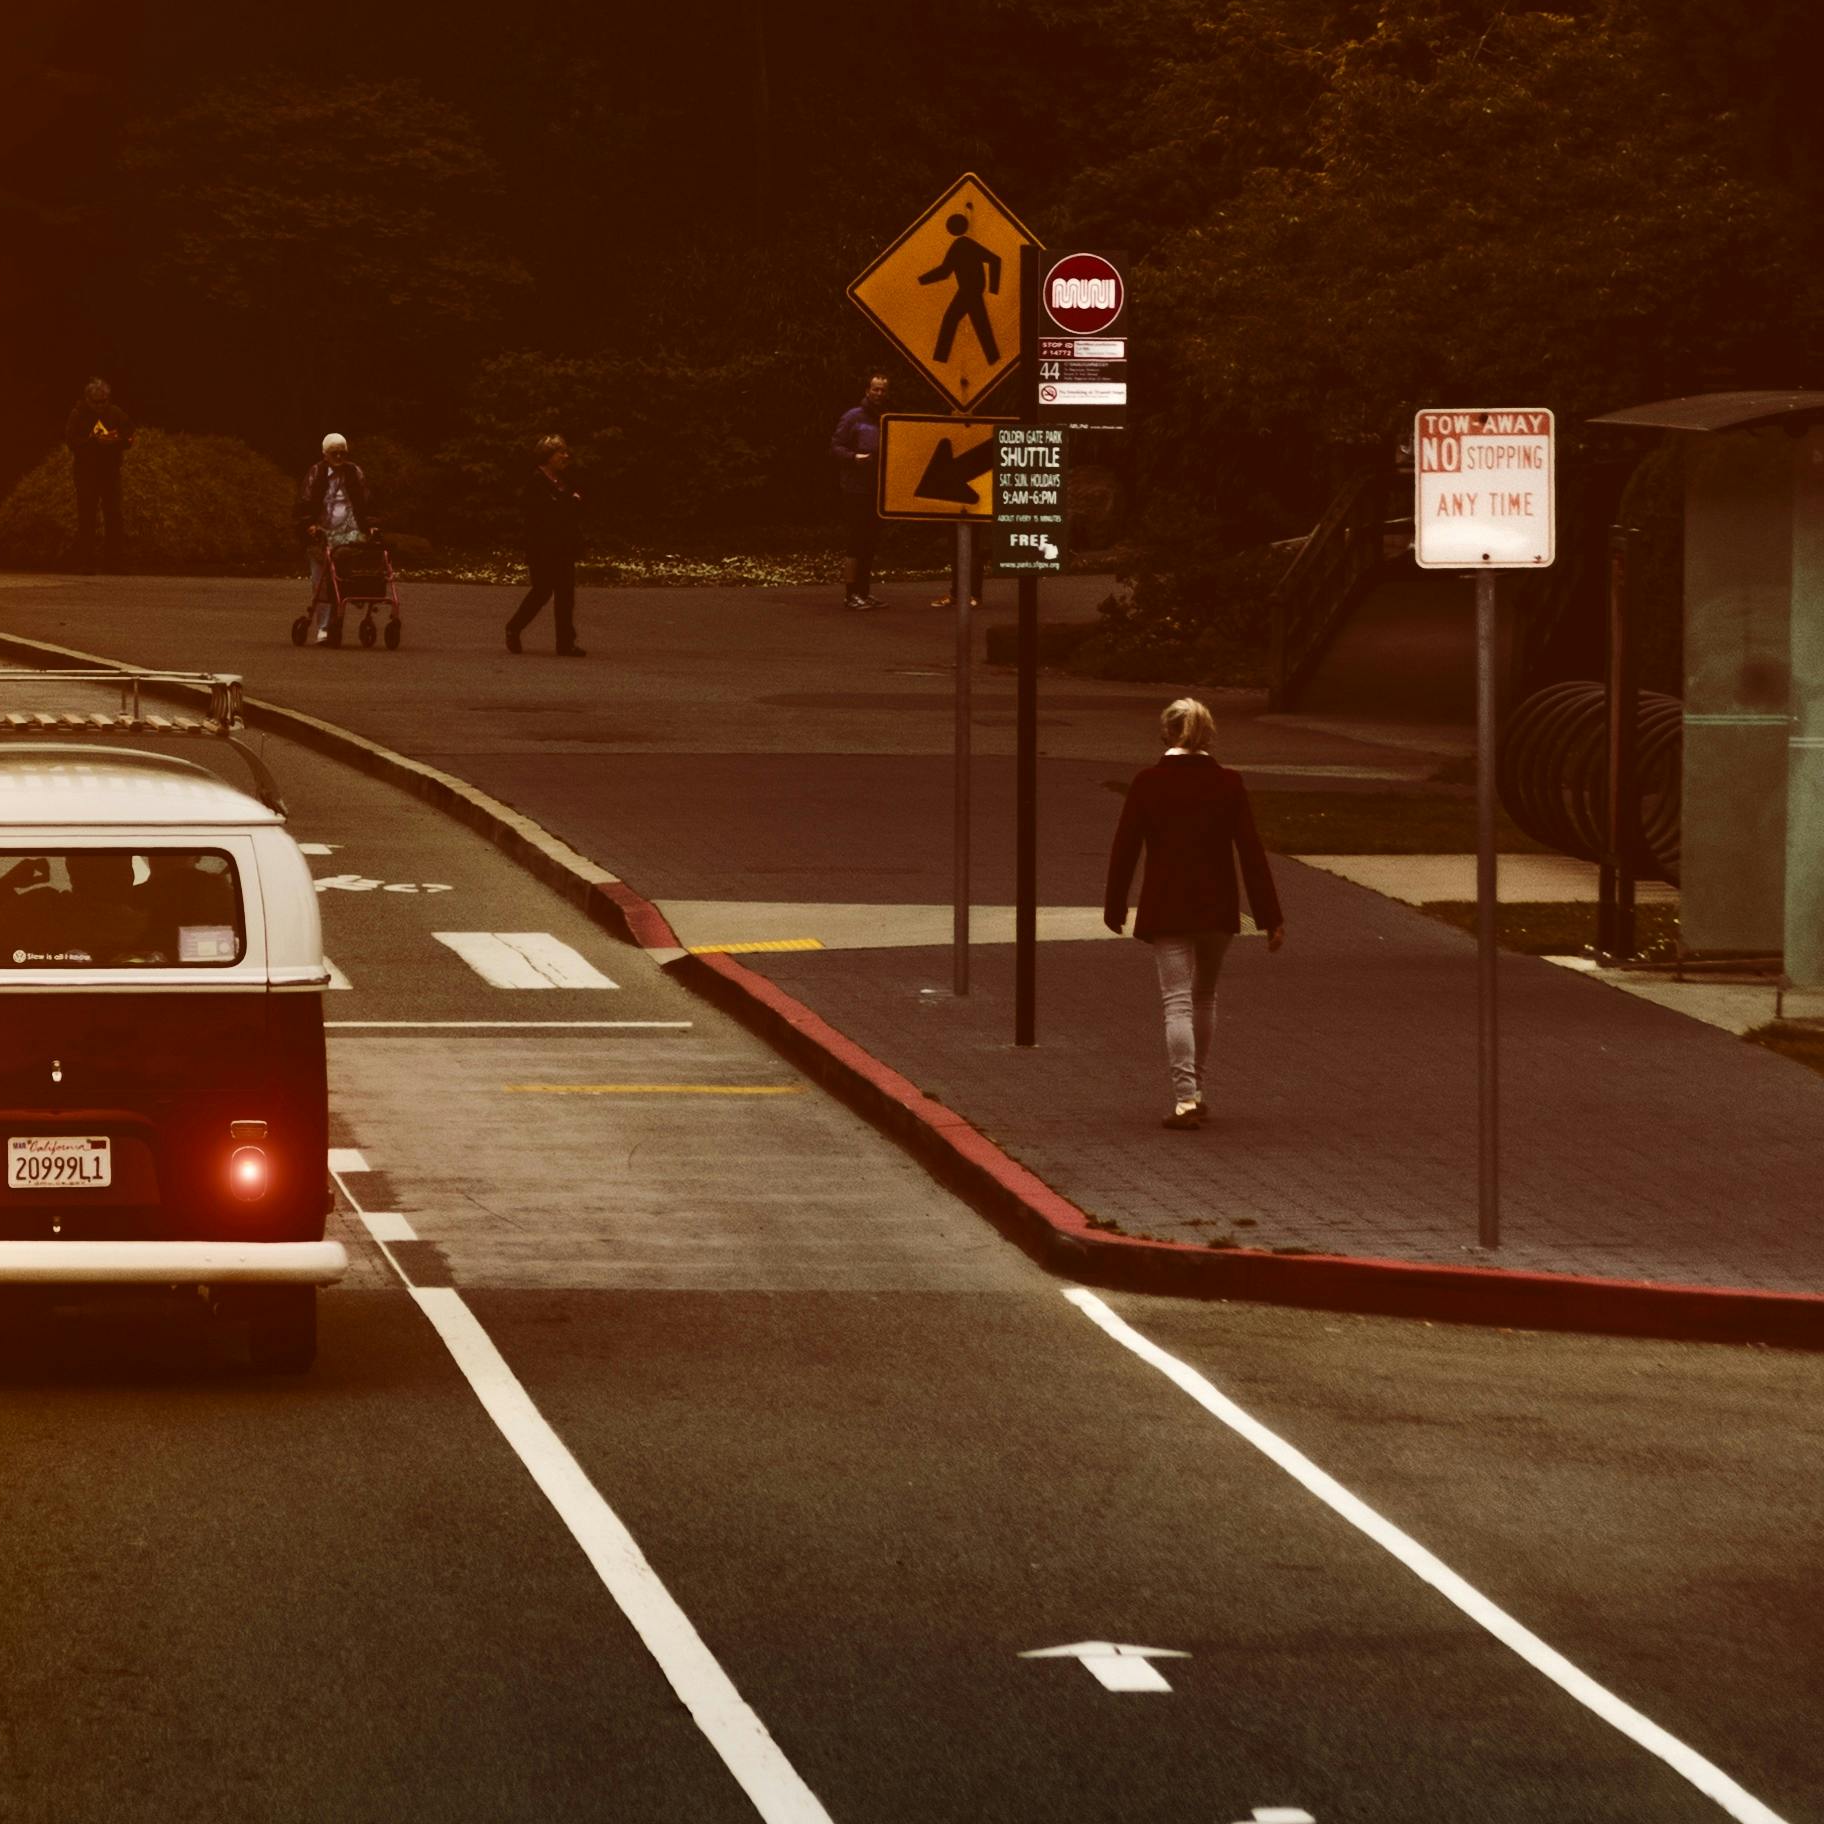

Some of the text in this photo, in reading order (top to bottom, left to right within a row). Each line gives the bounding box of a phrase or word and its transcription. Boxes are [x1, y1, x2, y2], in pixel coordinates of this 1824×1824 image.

[1039, 362, 1060, 380] 44
[1425, 415, 1544, 434] TOW-AWAY
[999, 430, 1062, 444] GOLDEN GATE PARK
[1000, 446, 1060, 468] SHUTTLE
[1422, 437, 1544, 472] NO STOPPING
[1030, 473, 1060, 488] HOLIDAYS
[1436, 492, 1535, 517] ANY TIME
[1010, 533, 1049, 547] FREE
[28, 1140, 86, 1156] California
[15, 1156, 104, 1181] 20999L1
